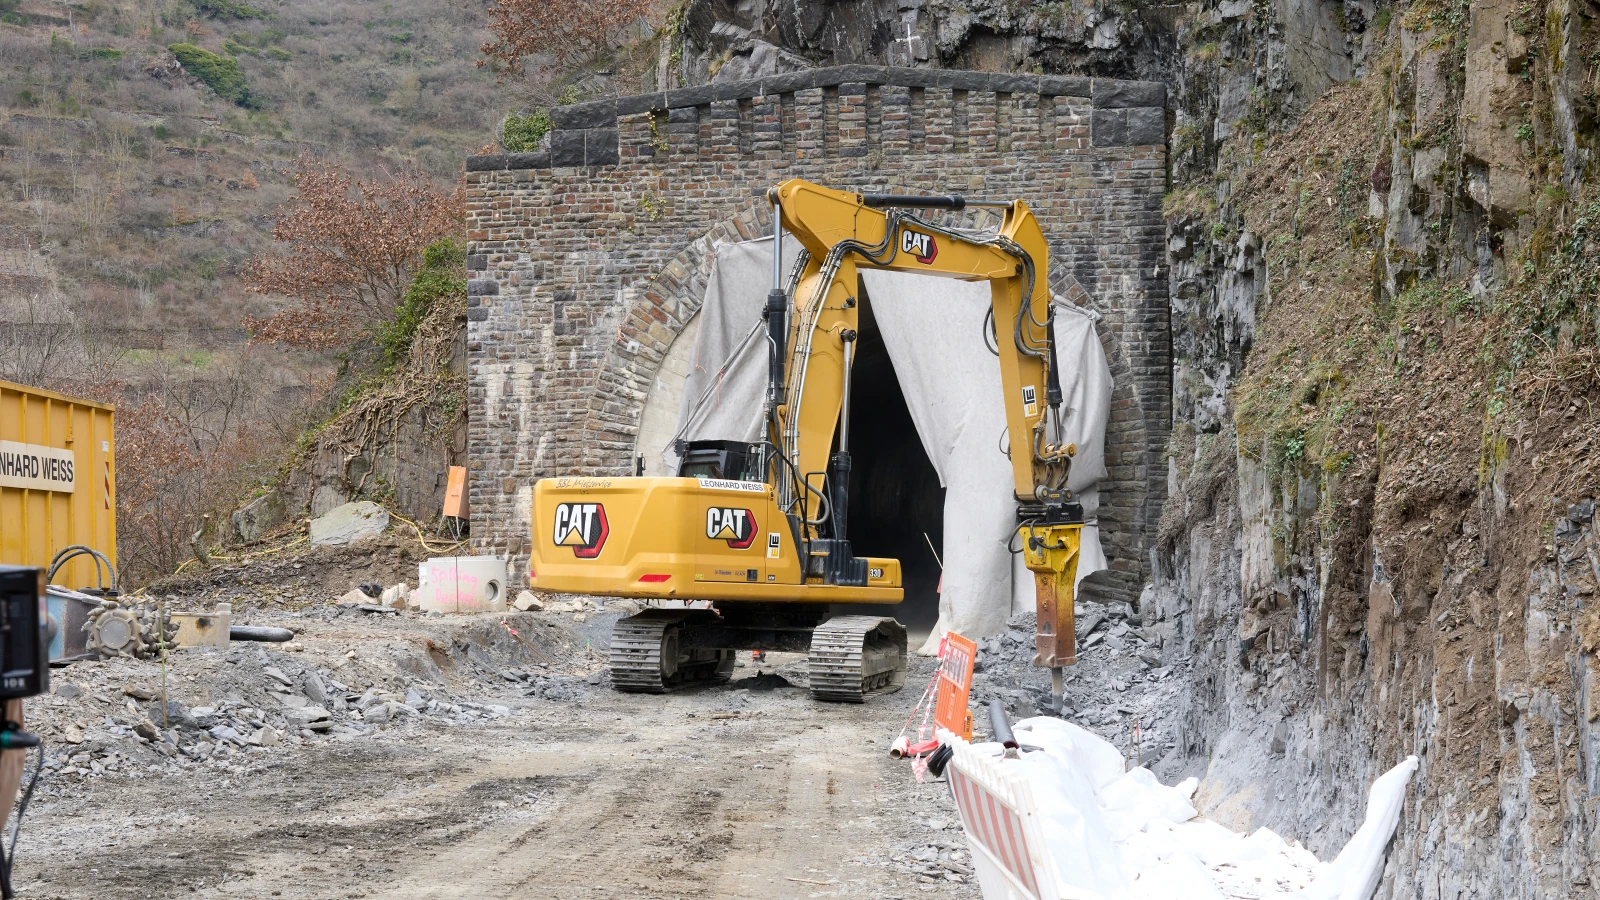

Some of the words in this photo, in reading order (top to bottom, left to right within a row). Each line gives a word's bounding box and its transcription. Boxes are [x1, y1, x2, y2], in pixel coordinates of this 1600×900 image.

[902, 230, 930, 257] CAT
[41, 457, 74, 482] WEISS
[700, 480, 740, 489] LEONHARD
[741, 483, 764, 492] WEISS
[554, 503, 597, 545] CAT
[707, 507, 746, 539] CAT
[869, 568, 882, 578] 330
